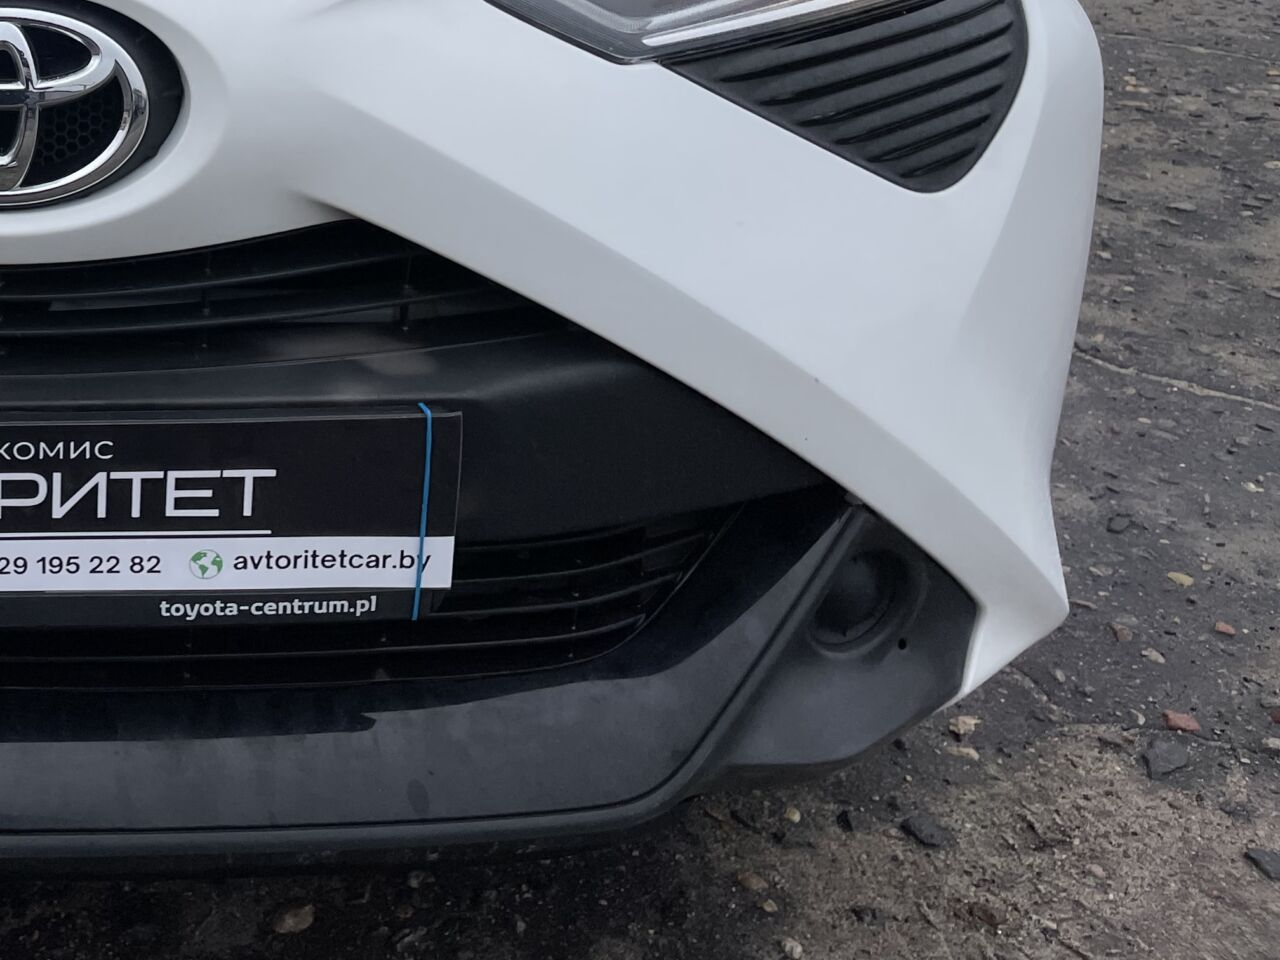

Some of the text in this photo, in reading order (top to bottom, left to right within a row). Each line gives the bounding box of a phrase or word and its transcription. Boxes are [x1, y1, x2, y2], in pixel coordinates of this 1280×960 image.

[35, 555, 81, 575] 195
[88, 555, 121, 575] 22
[129, 554, 162, 575] 82
[233, 548, 432, 574] avtoritetcar.by
[160, 596, 378, 621] toyota-centrum.pl
